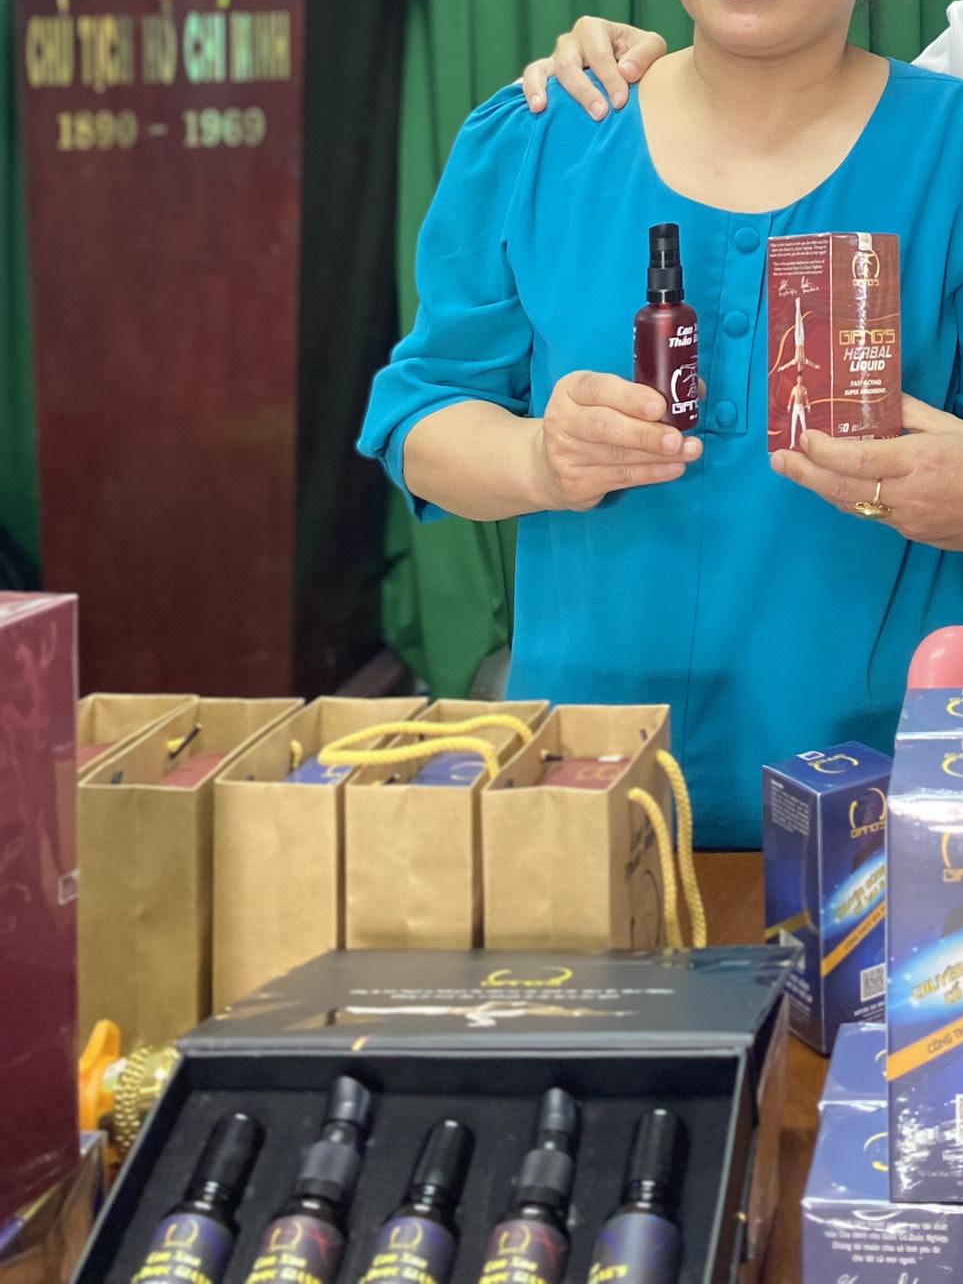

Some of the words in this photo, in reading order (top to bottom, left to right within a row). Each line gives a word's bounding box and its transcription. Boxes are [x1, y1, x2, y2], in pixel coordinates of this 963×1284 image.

[183, 106, 267, 148] 1969
[843, 345, 893, 361] HERBAL
[849, 359, 886, 373] LIQUID
